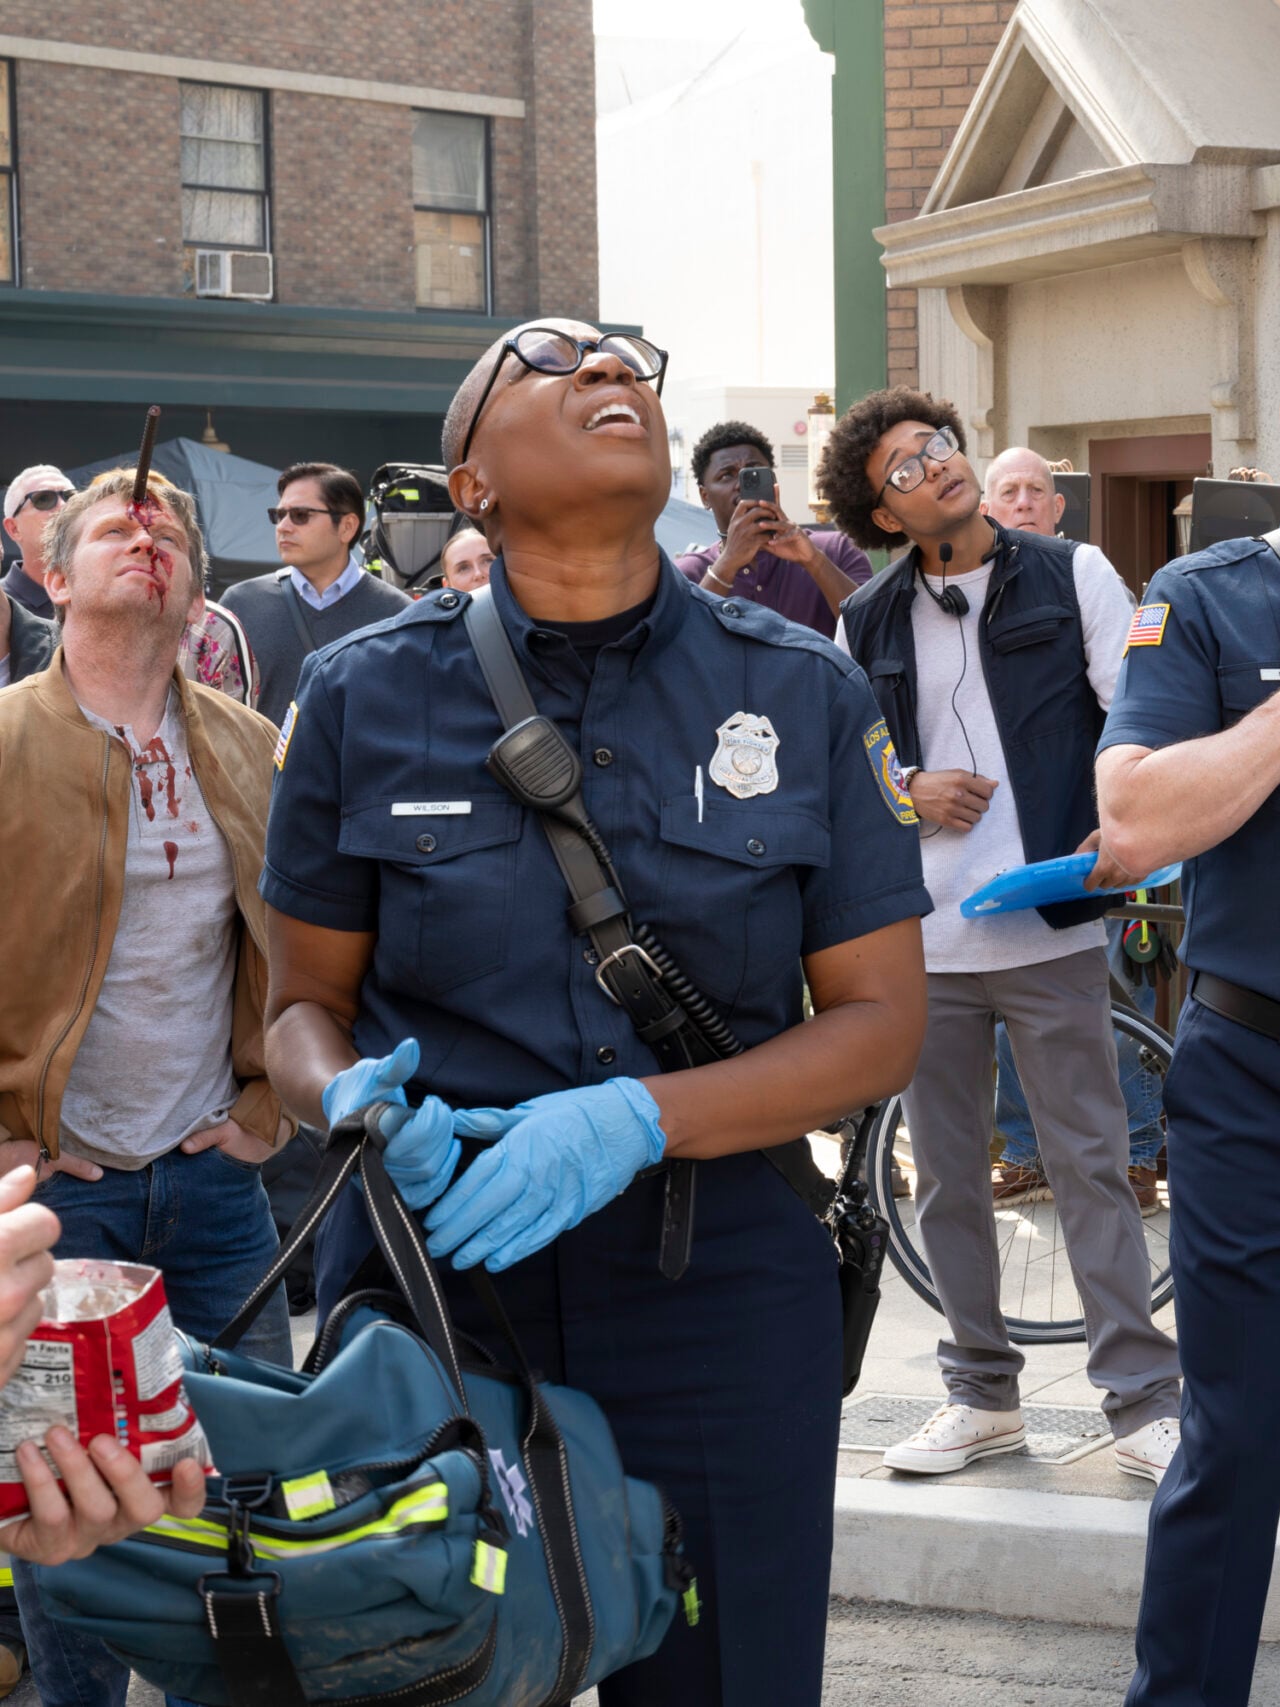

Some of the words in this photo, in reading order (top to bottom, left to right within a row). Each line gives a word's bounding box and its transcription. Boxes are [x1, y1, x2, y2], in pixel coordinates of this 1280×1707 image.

[866, 730, 881, 749] LOS
[413, 804, 450, 812] WILSON
[40, 1343, 69, 1353] Facts
[45, 1373, 71, 1384] 210
